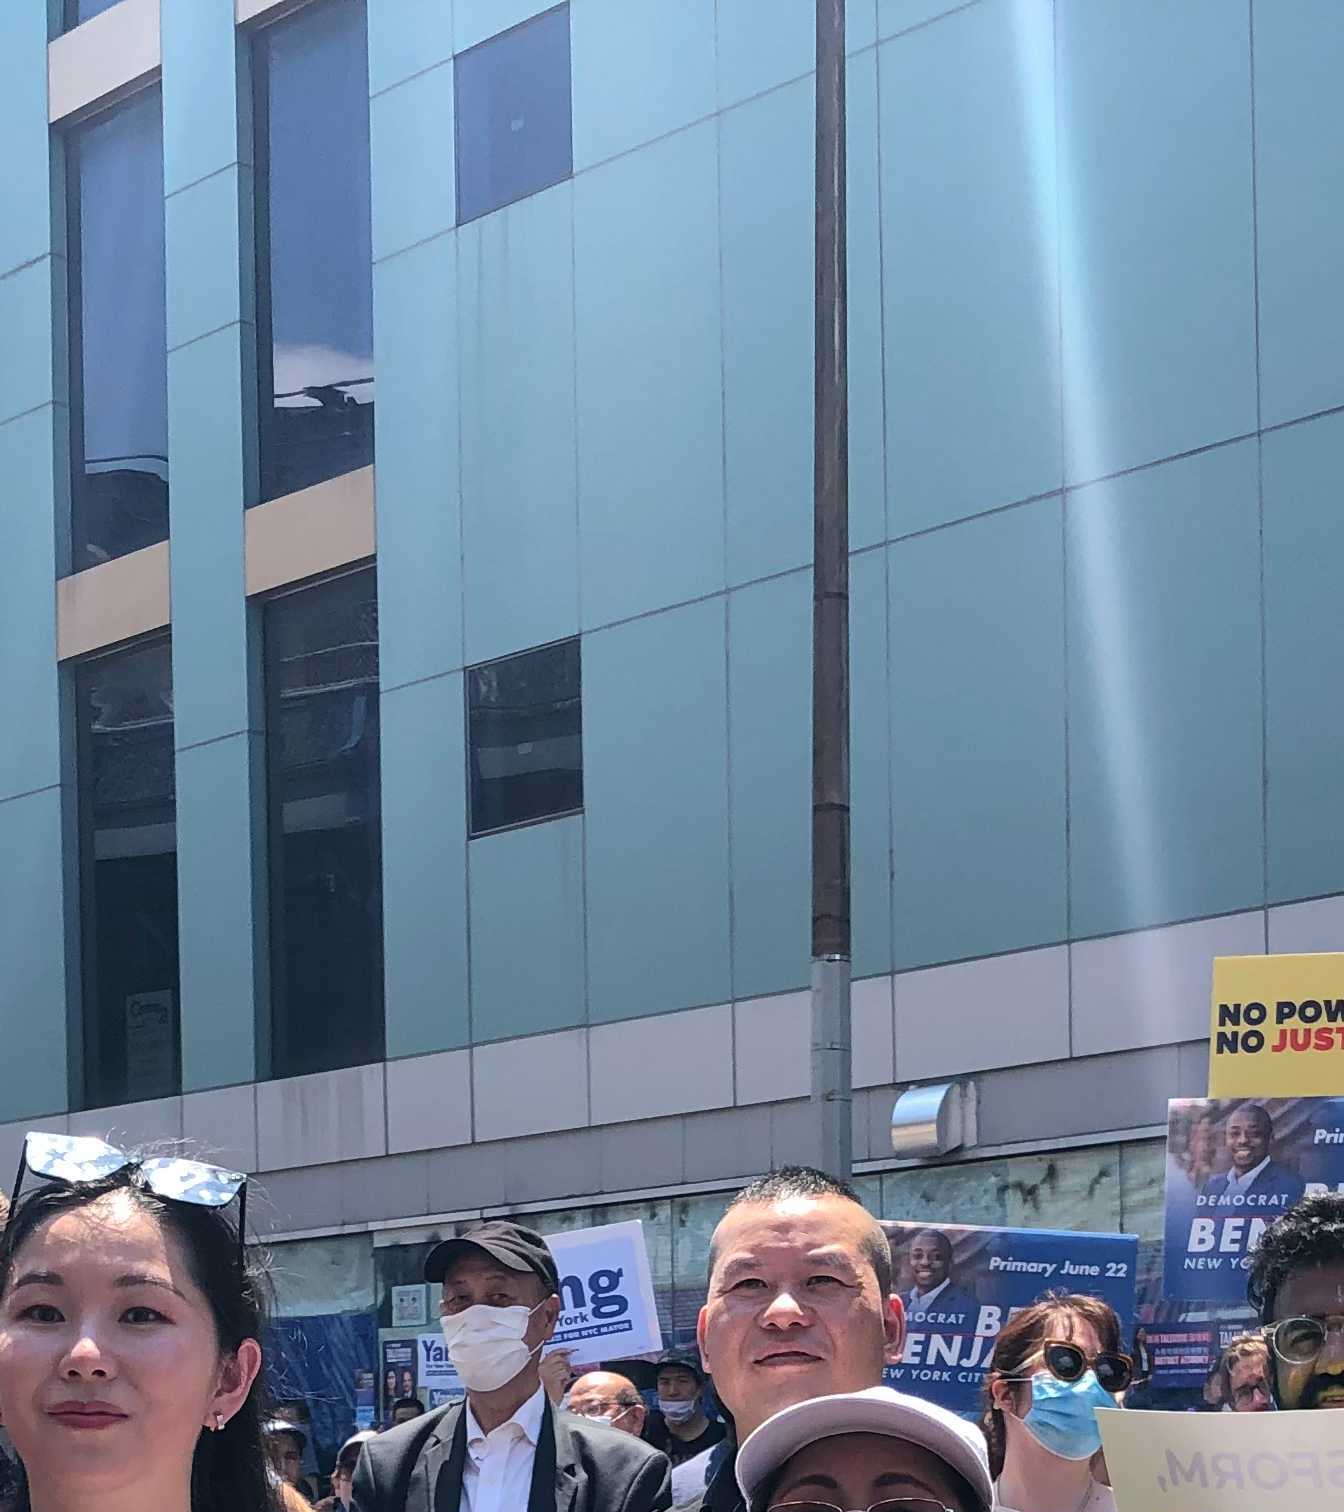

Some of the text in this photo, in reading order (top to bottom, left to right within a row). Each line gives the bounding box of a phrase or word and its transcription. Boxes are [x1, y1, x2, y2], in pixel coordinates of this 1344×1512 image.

[1218, 1001, 1267, 1027] NO
[1216, 1029, 1265, 1054] NO
[1195, 1194, 1289, 1207] DEMOCRAT
[989, 1256, 1128, 1278] Primary June 22
[1183, 1257, 1253, 1270] NEW YO
[558, 1267, 629, 1320] ng
[904, 1311, 966, 1325] MOCRAT
[422, 1340, 449, 1362] Ya
[881, 1368, 904, 1380] EW
[911, 1368, 952, 1382] YORK
